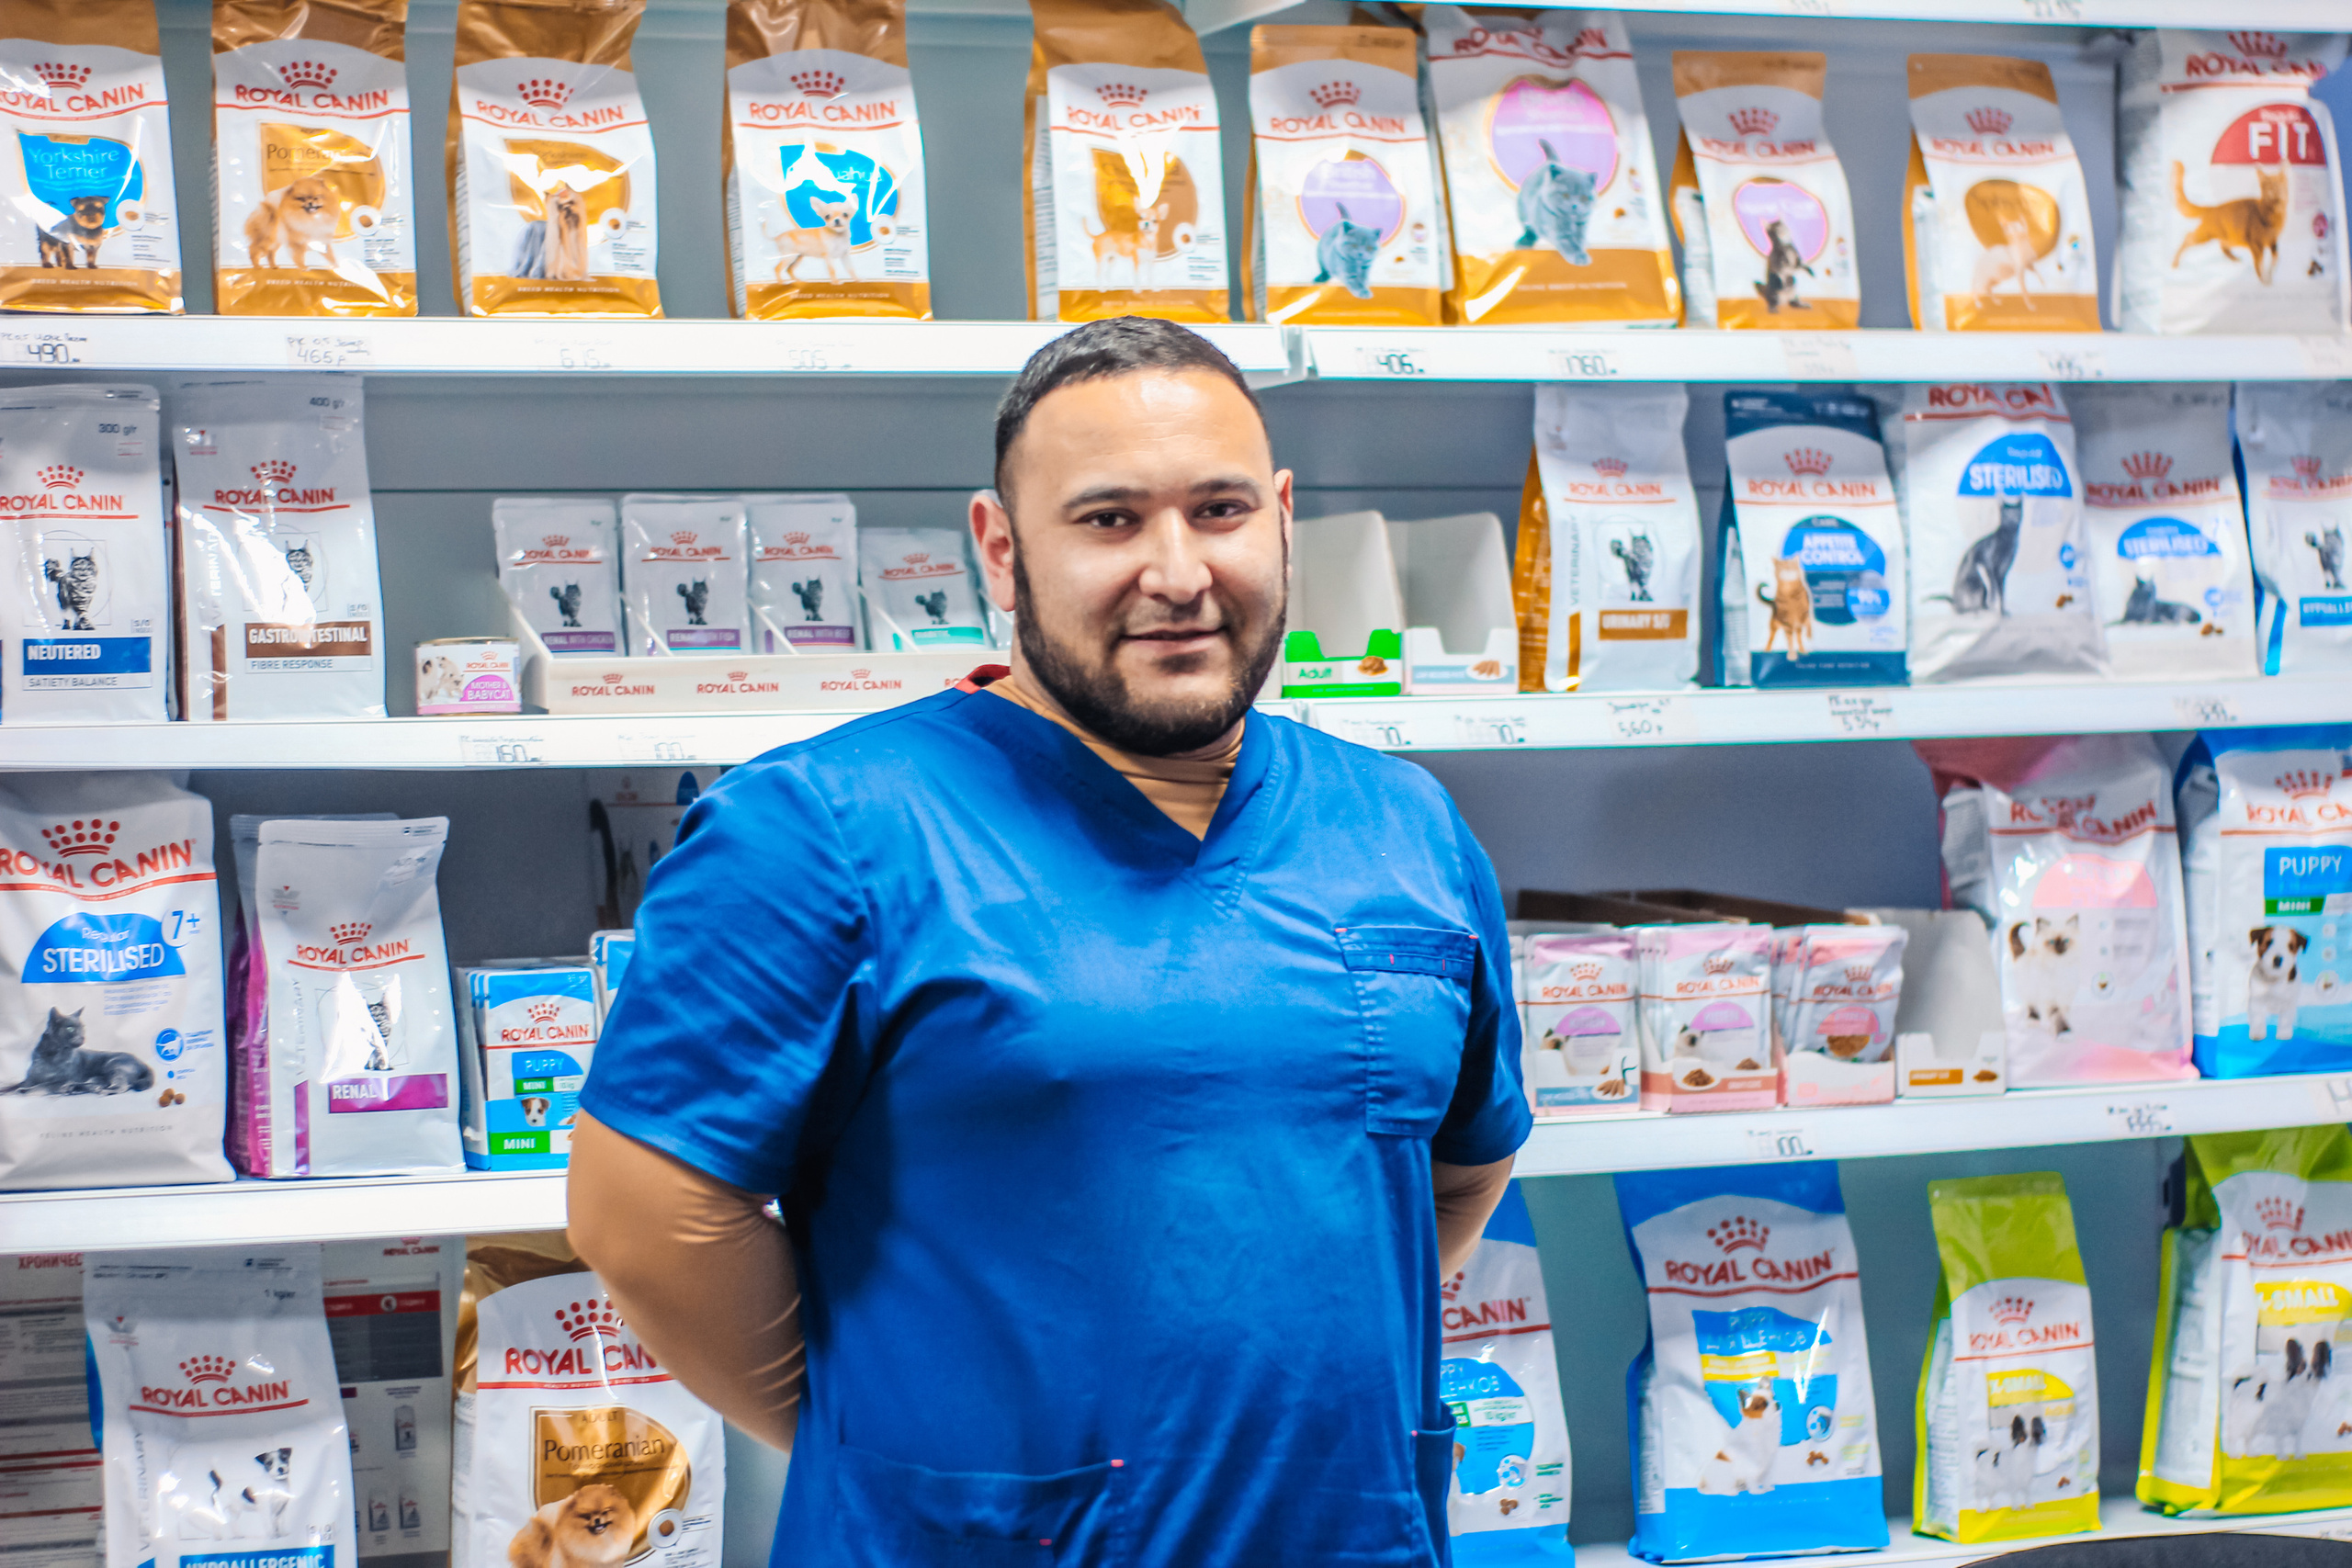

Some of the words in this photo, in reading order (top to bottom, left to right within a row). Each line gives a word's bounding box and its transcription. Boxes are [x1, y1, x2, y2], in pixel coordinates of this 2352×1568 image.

[67, 84, 144, 112] CANIN
[235, 85, 307, 107] ROYAL
[313, 89, 388, 110] CANIN
[477, 101, 544, 126] ROYAL
[549, 106, 625, 127] CANIN
[750, 102, 818, 120] ROYAL
[823, 101, 896, 121] CANIN
[1129, 106, 1201, 127] CANIN
[1271, 114, 1338, 133] ROYAL
[2248, 121, 2310, 160] FIT
[28, 147, 119, 164] Yorkshire
[277, 488, 334, 504] CANIN
[1569, 482, 1610, 496] ROYAL
[1615, 482, 1661, 495] CANIN
[1747, 480, 1806, 497] ROYAL
[1814, 480, 1876, 497] CANIN
[0, 494, 58, 511] ROYAL
[62, 494, 124, 511] CANIN
[1803, 532, 1858, 550] APPETITE
[764, 547, 794, 557] ROYAL
[799, 546, 833, 556] CANIN
[1802, 549, 1865, 566] CONTROL
[884, 566, 916, 577] ROYAL
[921, 563, 955, 573] CANIN
[249, 627, 368, 644] GASTROTESTINAL
[27, 644, 102, 660] NEUTERED
[252, 660, 279, 671] FIBRE
[283, 659, 334, 670] RESPONSE
[1298, 668, 1332, 679] Adult
[28, 678, 69, 688] SATIETY
[72, 676, 118, 687] BALANCE
[571, 686, 611, 696] ROYAL
[615, 685, 655, 695] CANIN
[696, 683, 736, 694] ROYAL
[740, 682, 779, 693] CANIN
[820, 681, 859, 691] ROYAL
[864, 680, 902, 690] CANIN
[468, 690, 510, 700] BABYCAT
[0, 848, 84, 888] ROYAL
[90, 840, 191, 887] CANIN
[2279, 855, 2342, 876] PUPPY
[82, 927, 130, 943] Regular
[42, 943, 165, 974] STERILISED
[297, 944, 347, 964] ROYAL
[351, 940, 410, 963] CANIN
[1543, 986, 1583, 998] ROYAL
[1588, 983, 1627, 996] CANIN
[1677, 982, 1715, 994] ROYAL
[1720, 977, 1759, 991] CANIN
[1814, 985, 1852, 997] ROYAL
[502, 1027, 543, 1042] ROYAL
[547, 1024, 589, 1039] CANIN
[526, 1058, 564, 1073] PUPPY
[333, 1084, 377, 1100] RENAL
[523, 1080, 547, 1090] MINI
[79, 1127, 115, 1137] HEALTH
[120, 1124, 174, 1134] NUTRITION
[503, 1138, 536, 1150] MINI
[1665, 1259, 1746, 1285] ROYAL
[1752, 1251, 1833, 1282] CANIN
[1442, 1297, 1527, 1330] CANIN
[505, 1348, 592, 1375] ROYAL
[141, 1385, 209, 1408] ROYAL
[213, 1382, 288, 1405] CANIN
[582, 1410, 617, 1424] ADULT
[544, 1435, 664, 1461] Pomeranian
